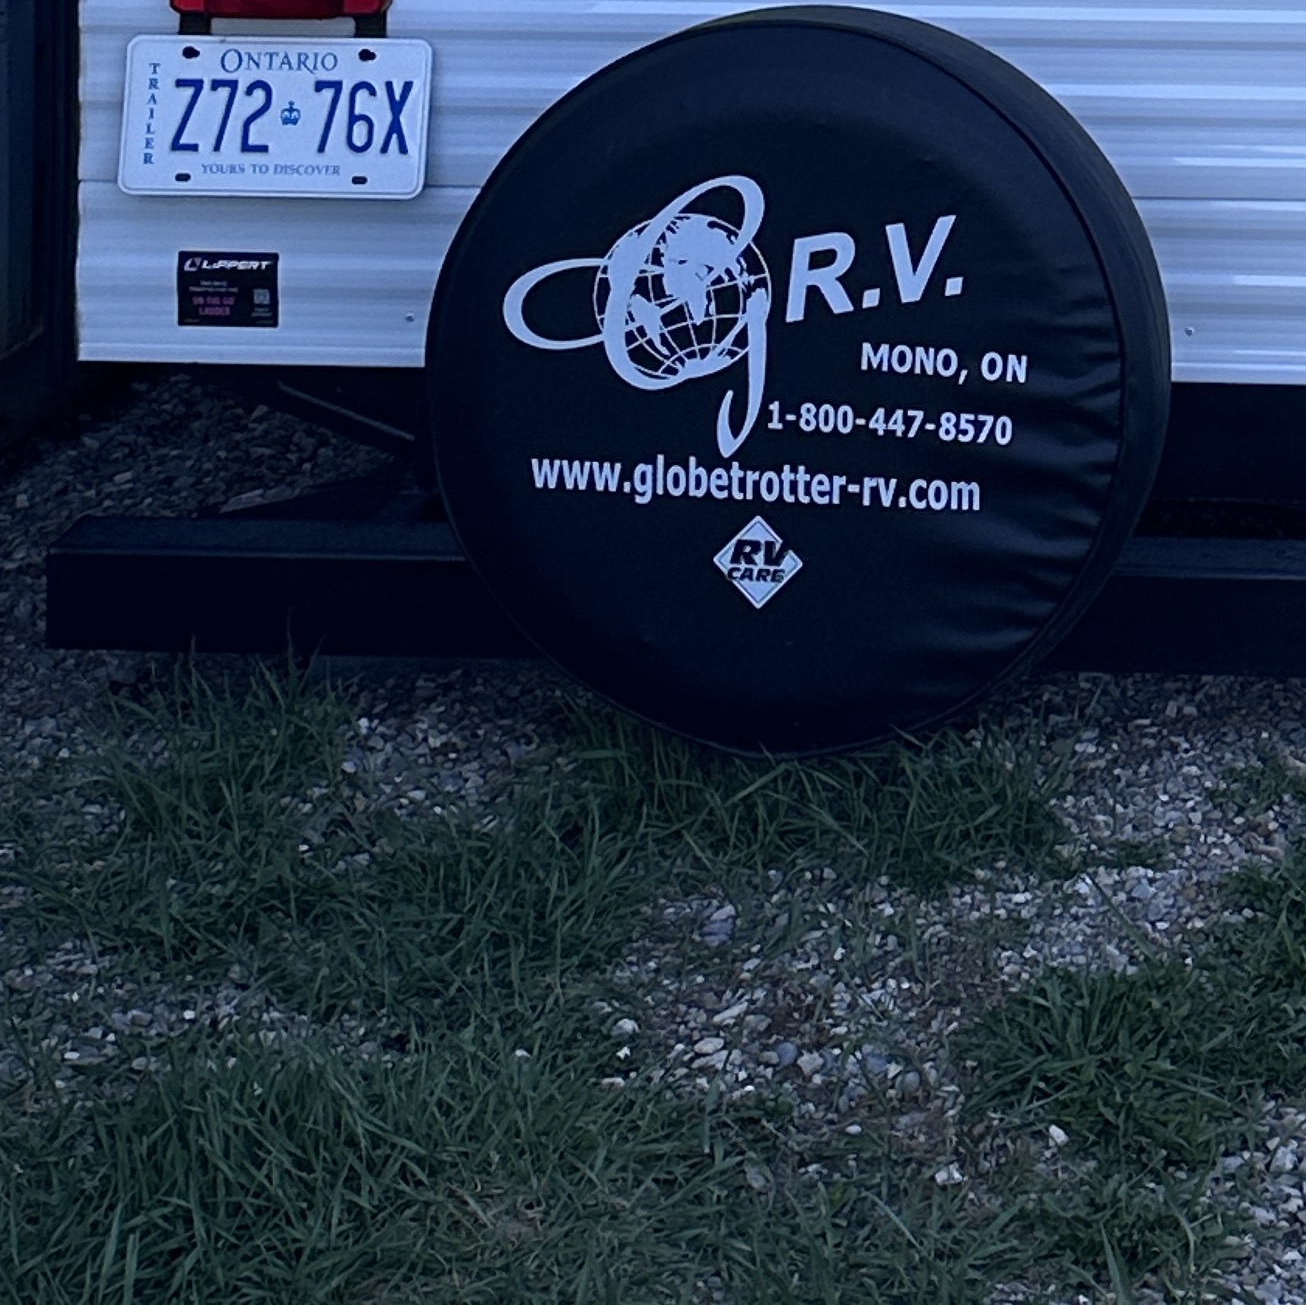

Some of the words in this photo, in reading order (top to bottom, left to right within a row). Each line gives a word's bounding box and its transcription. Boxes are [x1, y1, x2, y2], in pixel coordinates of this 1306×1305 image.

[143, 63, 161, 164] TRAILER
[200, 163, 246, 176] YOURS
[251, 164, 270, 176] TO
[273, 164, 341, 177] DISCOVER
[786, 215, 964, 322] R.V.
[860, 342, 970, 385] MONO,
[981, 352, 1028, 384] ON
[766, 401, 1013, 446] 1-800-447-8570
[531, 455, 981, 512] www.globetrotter-rv.com
[729, 539, 788, 566] RV
[727, 567, 786, 583] CARE
